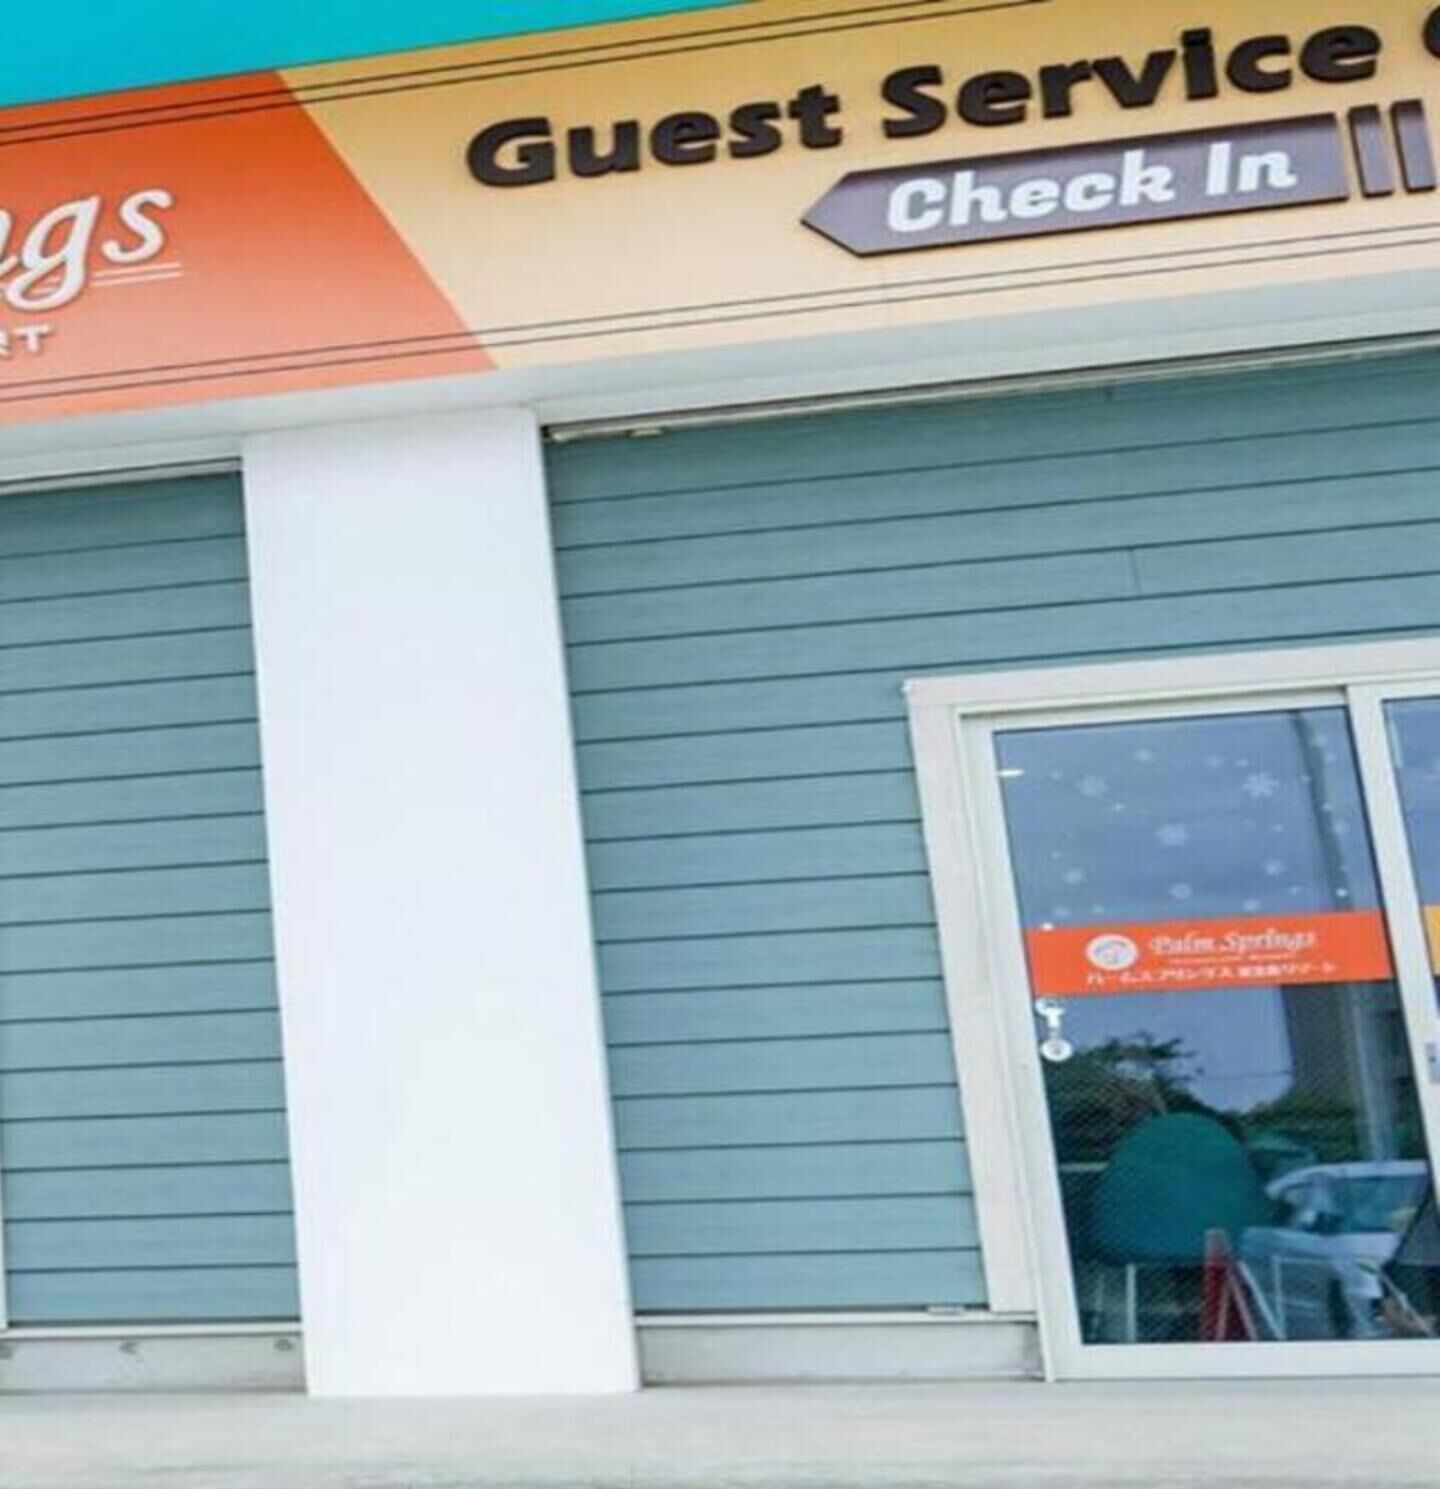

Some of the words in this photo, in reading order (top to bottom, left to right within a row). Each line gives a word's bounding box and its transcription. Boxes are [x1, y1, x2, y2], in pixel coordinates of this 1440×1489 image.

[467, 84, 843, 188] Guest
[881, 25, 1383, 138] Service
[886, 149, 1177, 233] Check
[1205, 141, 1298, 196] In
[1149, 931, 1214, 954] Palm
